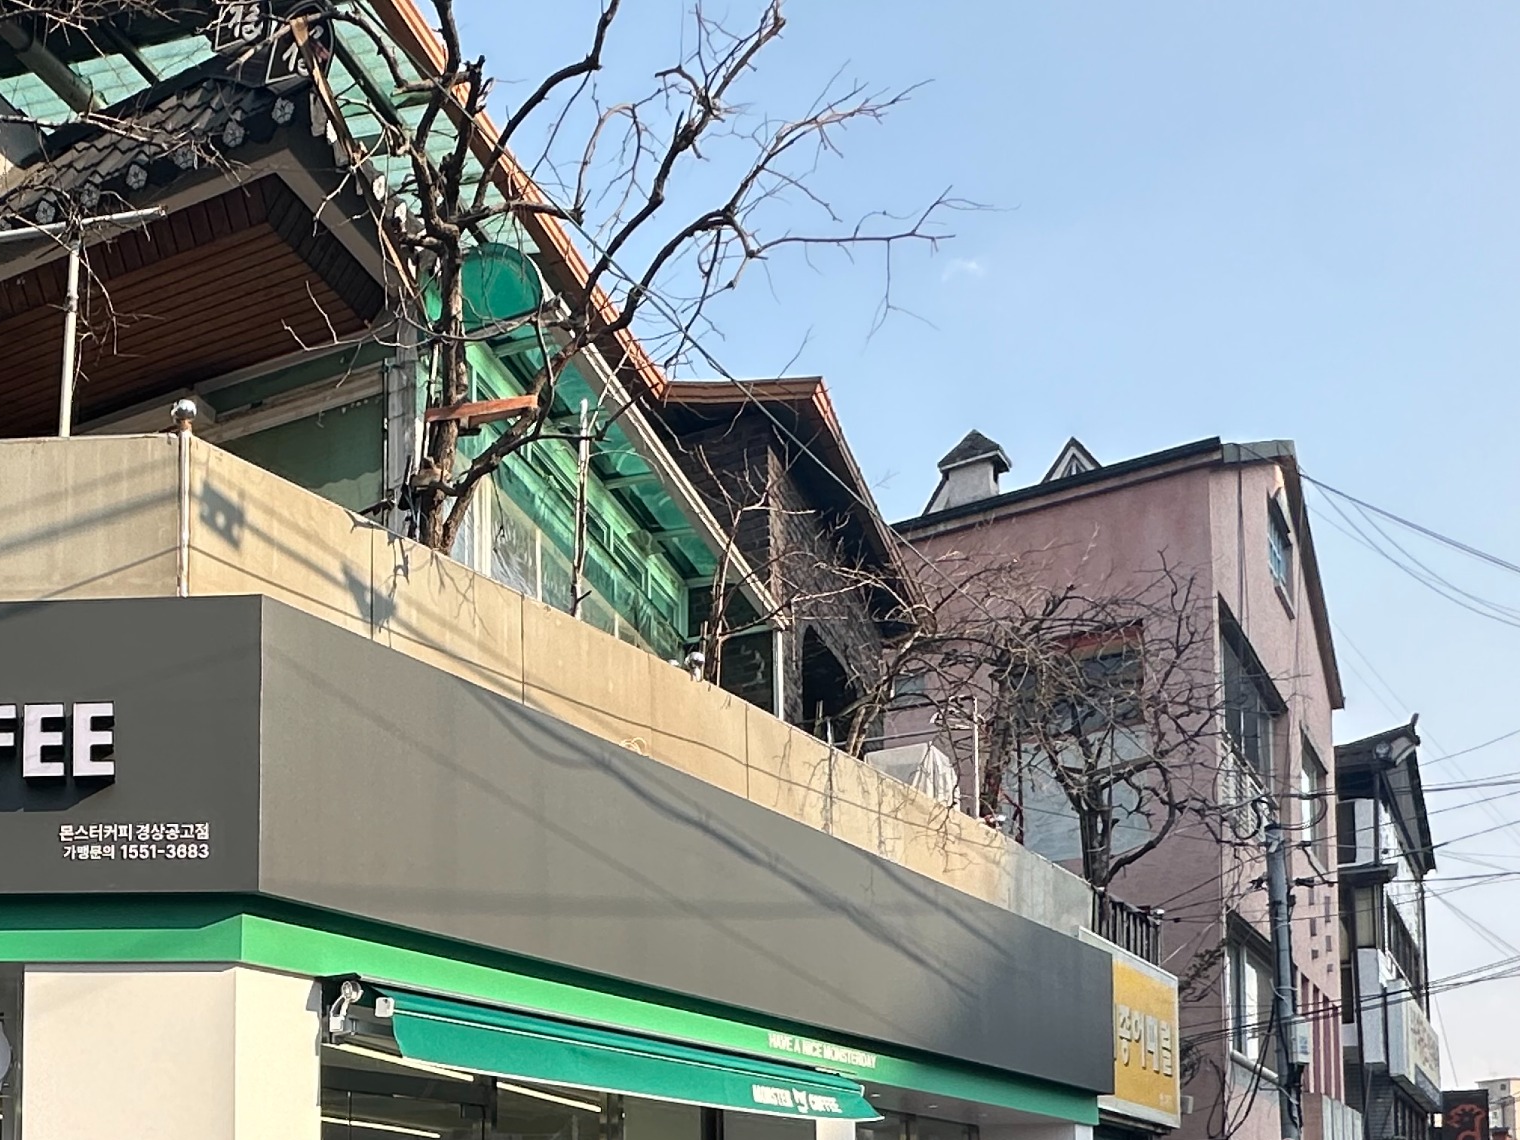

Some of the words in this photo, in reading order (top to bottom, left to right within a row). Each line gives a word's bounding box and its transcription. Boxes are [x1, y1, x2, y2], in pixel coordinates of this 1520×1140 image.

[59, 823, 133, 842] 몬스터커피
[136, 822, 210, 841] 경상공고점
[63, 845, 116, 860] 가맹문의
[120, 843, 210, 860] 1551-3683
